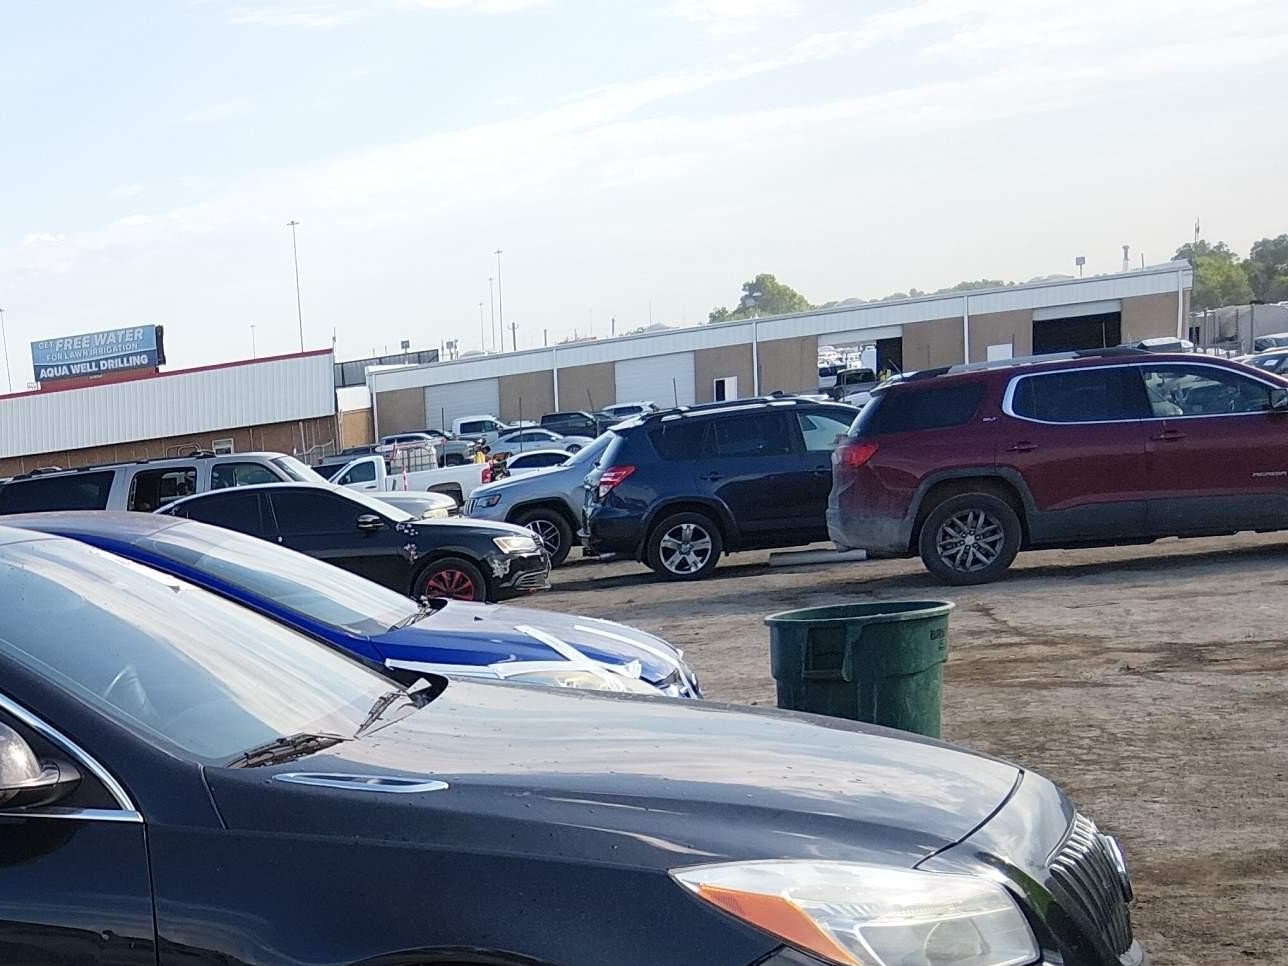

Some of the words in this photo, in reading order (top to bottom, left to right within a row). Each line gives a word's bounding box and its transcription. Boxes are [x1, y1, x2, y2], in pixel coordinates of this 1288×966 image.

[38, 341, 54, 350] GET
[55, 336, 90, 351] FREE
[94, 328, 144, 346] WATER
[39, 364, 69, 379] AQUA
[70, 361, 98, 374] WELL
[100, 354, 149, 370] DRILLING
